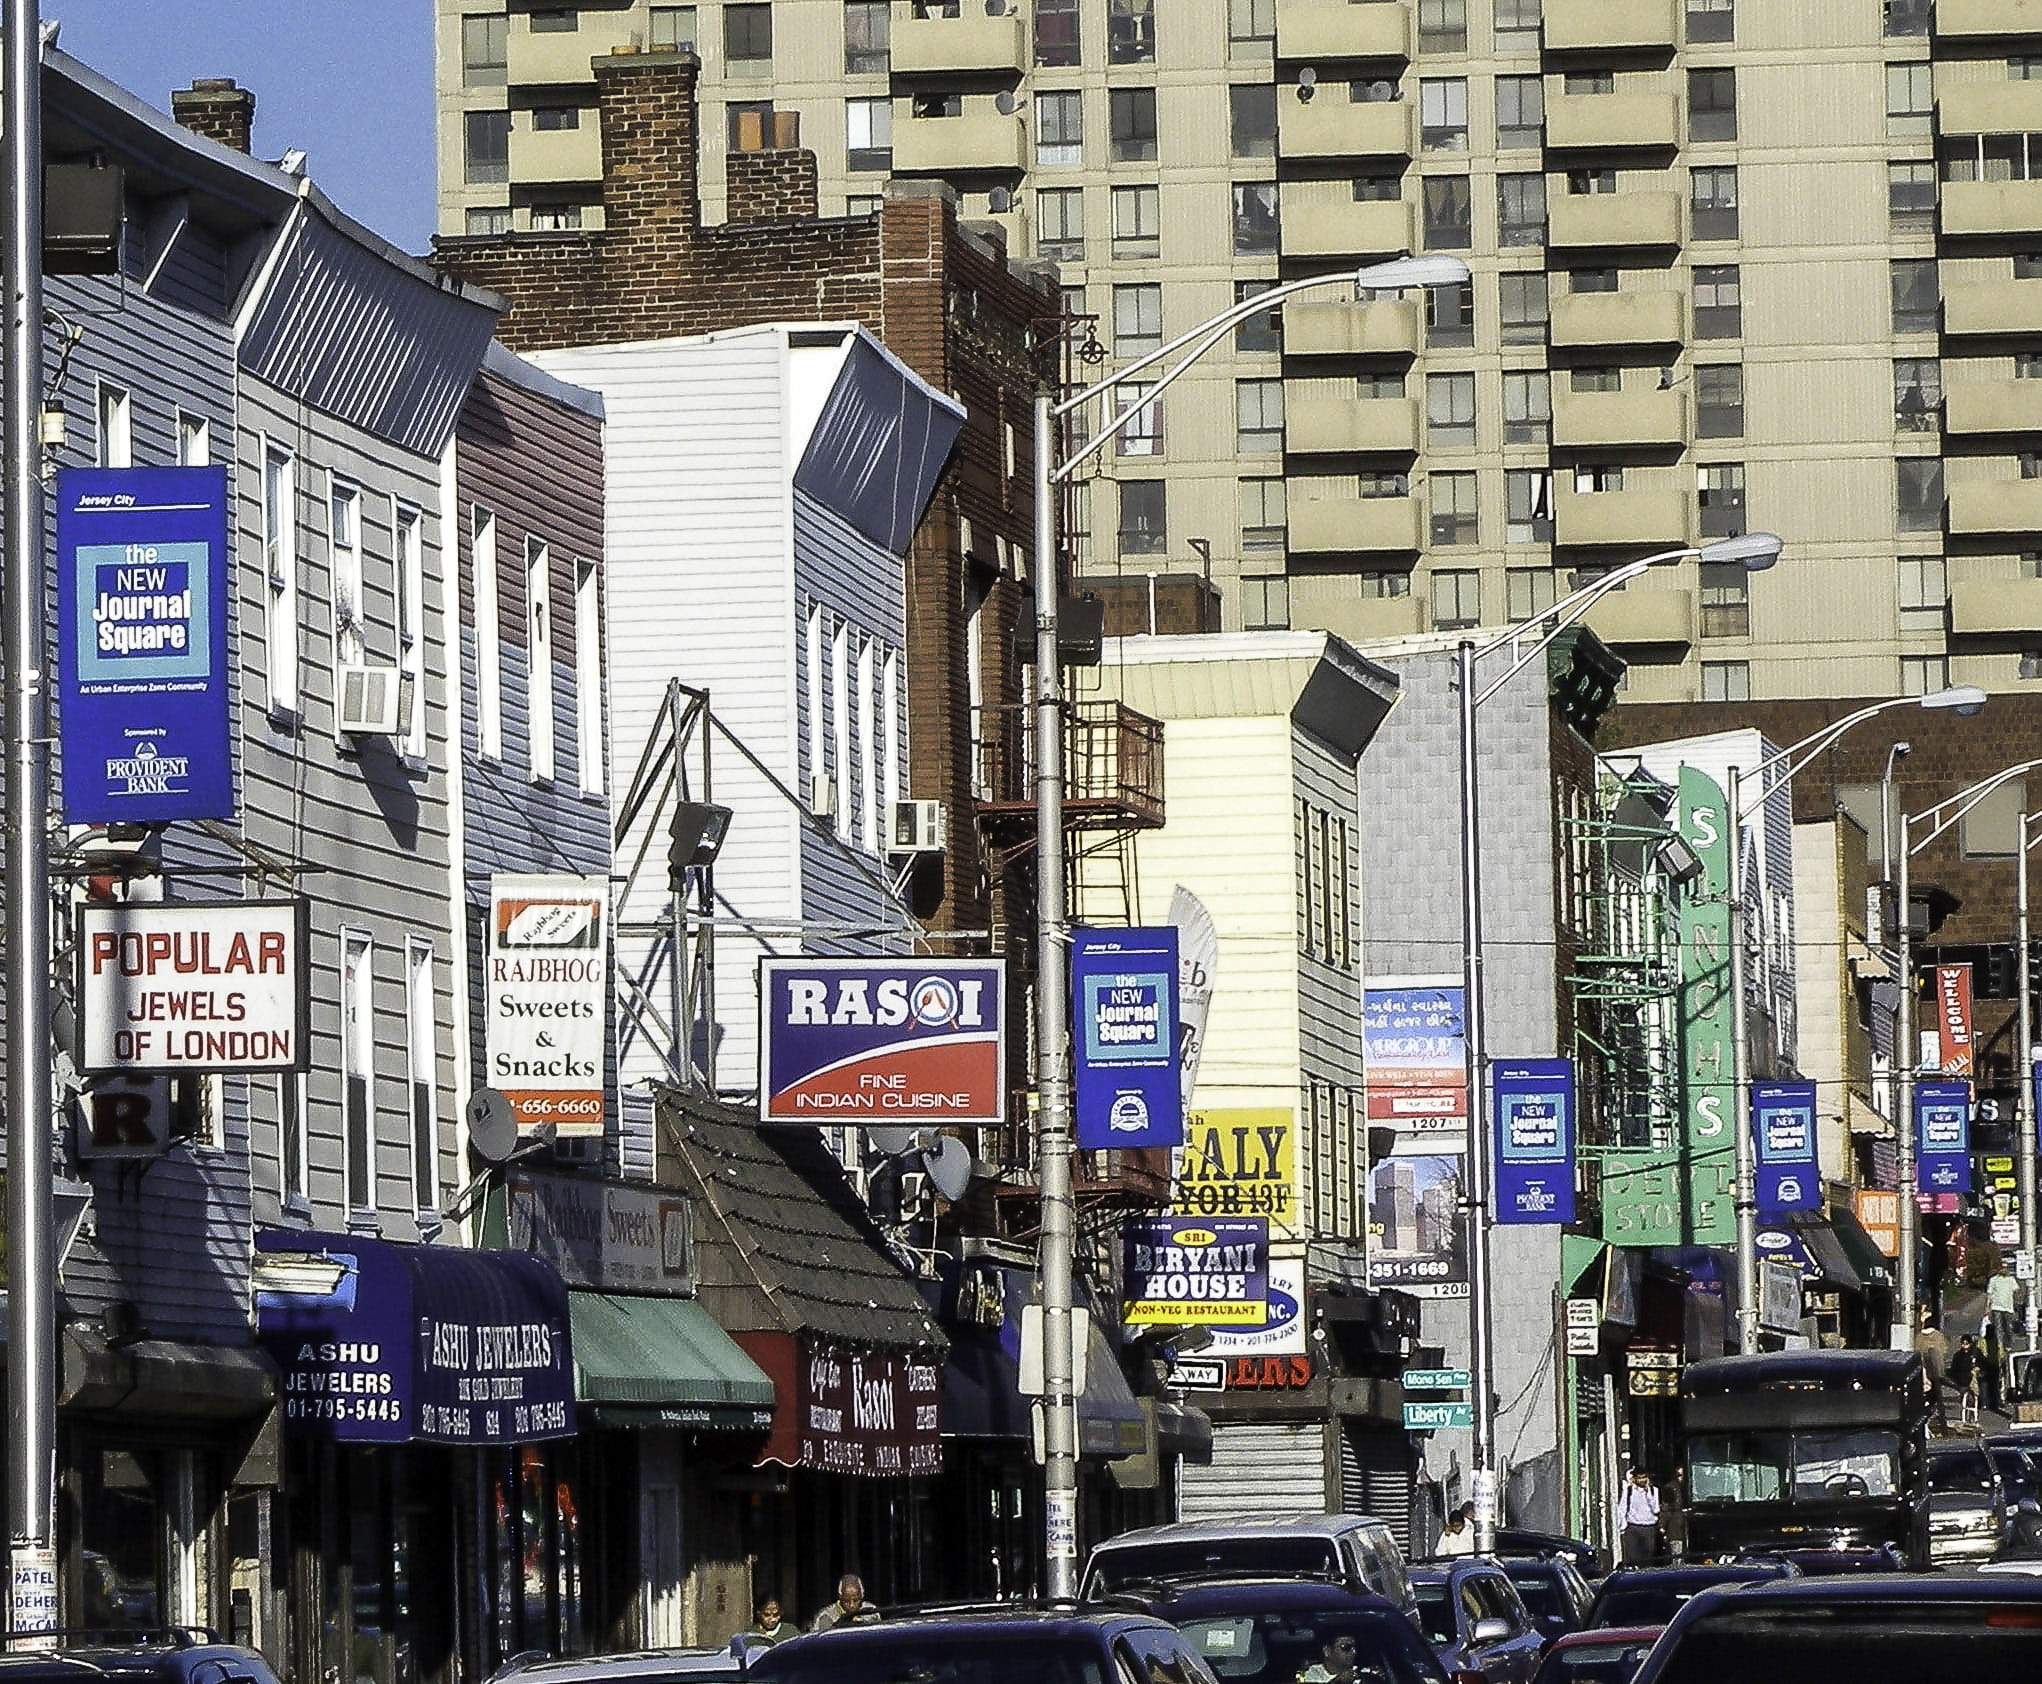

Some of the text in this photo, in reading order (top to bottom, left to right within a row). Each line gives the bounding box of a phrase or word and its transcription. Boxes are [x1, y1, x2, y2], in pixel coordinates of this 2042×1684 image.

[79, 494, 136, 507] Jersey City
[125, 544, 158, 564] the
[117, 567, 167, 592] NEW
[92, 589, 192, 622] Journal
[99, 621, 186, 655] Square
[106, 758, 189, 779] PROVIDENT
[127, 777, 169, 794] BANK
[92, 931, 286, 976] POPULAR
[493, 958, 600, 983] RAJBHOG
[1115, 974, 1137, 987] the
[126, 991, 247, 1021] JEWELS
[499, 993, 594, 1019] Sweets
[787, 978, 983, 1031] RASOI
[1111, 989, 1143, 1004] NEW
[1095, 1003, 1159, 1023] Journal
[535, 1030, 555, 1048] &
[1099, 1022, 1155, 1043] Square
[115, 1030, 290, 1061] OF LONDON
[496, 1052, 596, 1078] Snacks
[860, 1074, 907, 1089] FINE
[796, 1093, 971, 1109] INDIAN CUISINE
[1521, 1106, 1546, 1116] NEW
[1412, 1119, 1447, 1128] 1207
[1510, 1115, 1558, 1131] Journal
[1775, 1117, 1797, 1127] NEW
[1512, 1130, 1556, 1146] Square
[1615, 1201, 1716, 1231] STOE
[1183, 1232, 1207, 1242] SRI
[1134, 1243, 1257, 1273] BIRYANI
[1144, 1273, 1247, 1299] HOUSE
[1433, 1284, 1469, 1295] 1208
[1133, 1304, 1257, 1316] NON-VEG RESTAURANT
[297, 1343, 380, 1364] ASHU
[433, 1321, 551, 1372] ASHU JEWELERS
[286, 1371, 392, 1395] JEWELERS
[1187, 1369, 1213, 1380] WAY
[288, 1398, 401, 1422] 01-795-5445
[1408, 1406, 1453, 1427] Liberty
[15, 1571, 55, 1585] PATEL
